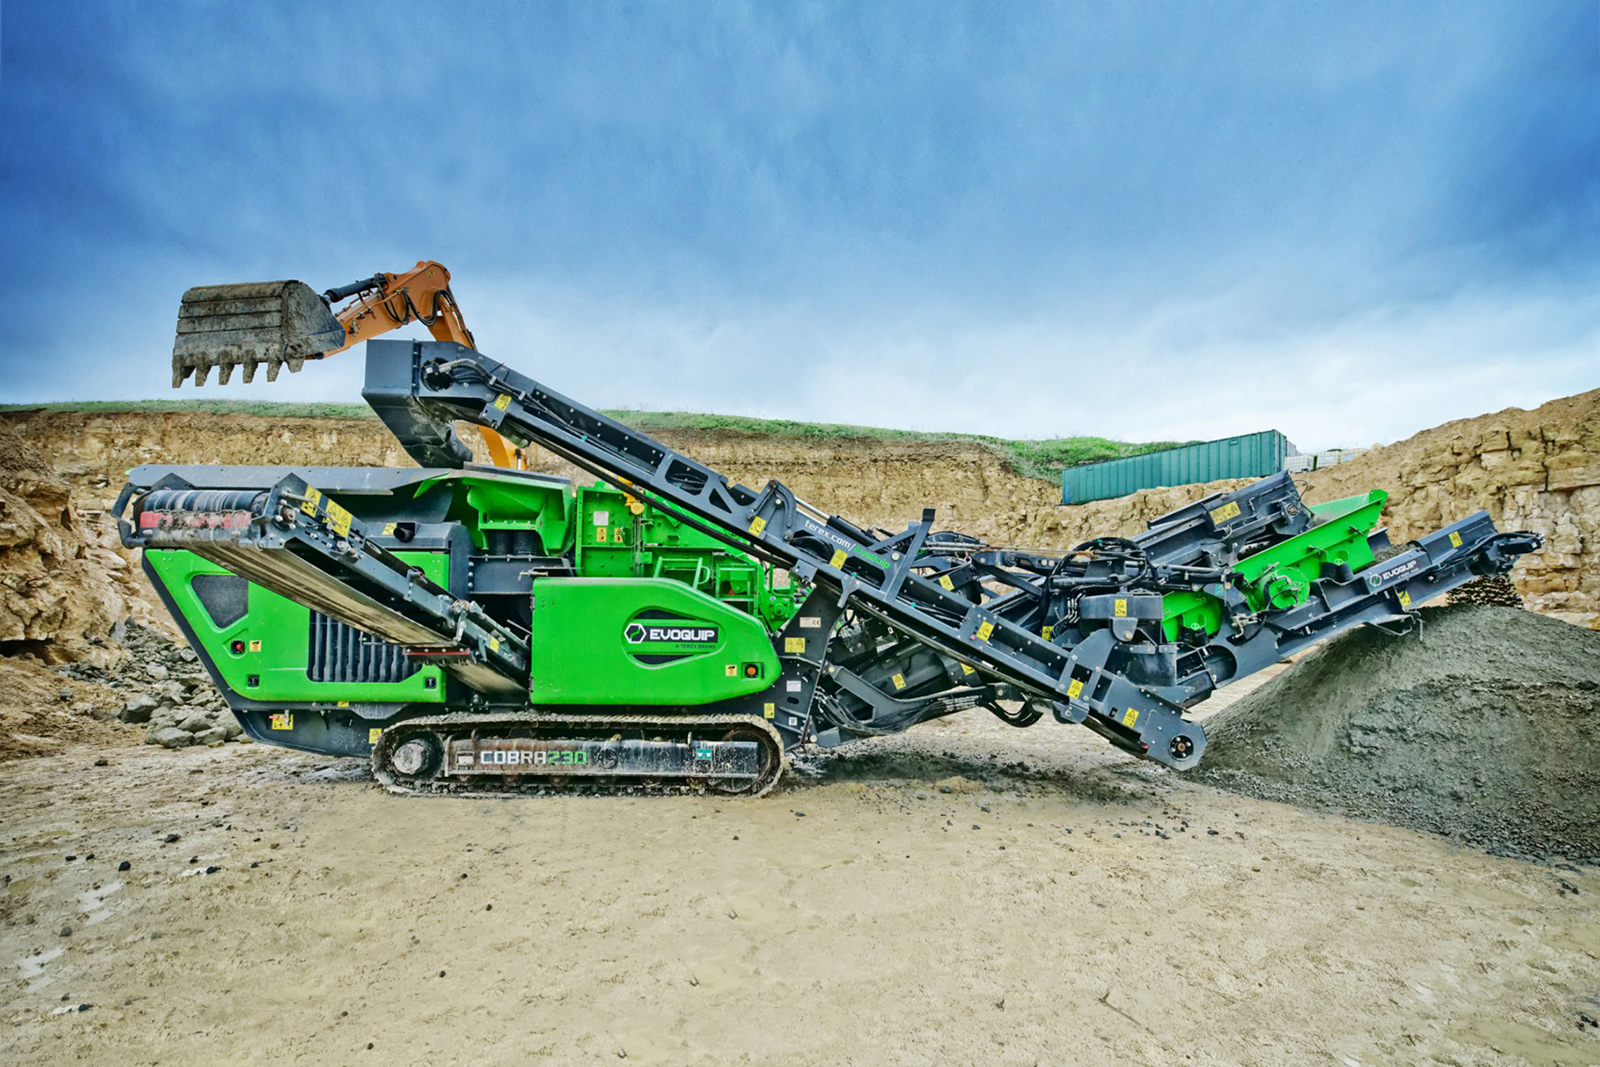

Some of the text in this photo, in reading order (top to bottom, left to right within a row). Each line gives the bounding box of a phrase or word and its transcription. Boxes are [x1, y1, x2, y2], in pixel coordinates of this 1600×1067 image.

[1382, 560, 1417, 580] EVOQUIP
[649, 628, 715, 641] EVOQUIP
[480, 750, 588, 766] COBRA230
